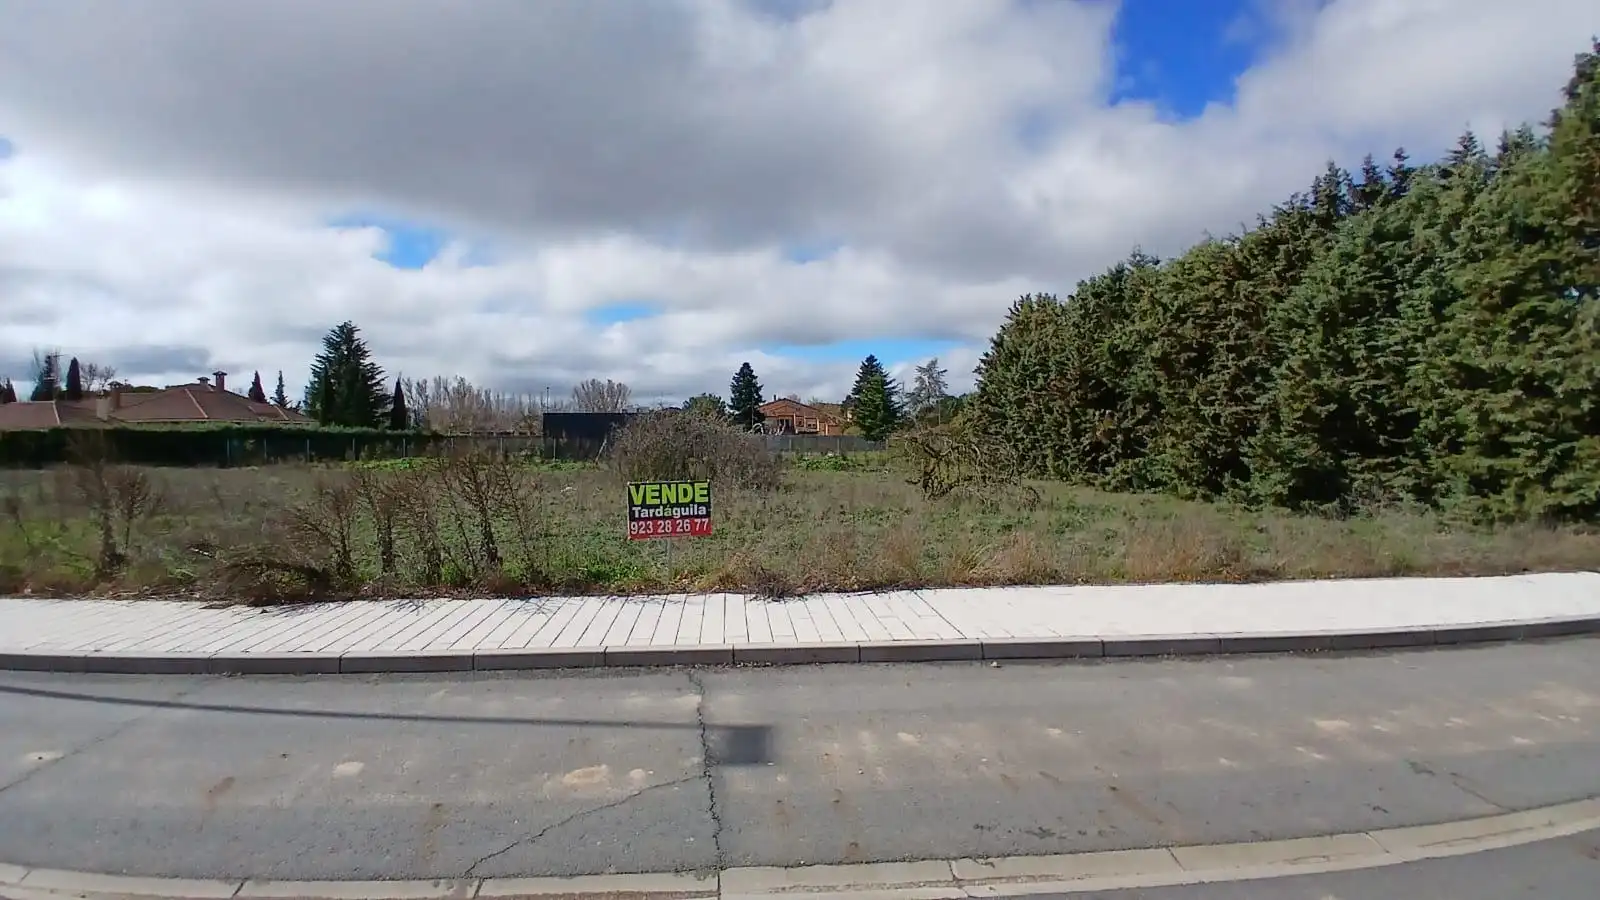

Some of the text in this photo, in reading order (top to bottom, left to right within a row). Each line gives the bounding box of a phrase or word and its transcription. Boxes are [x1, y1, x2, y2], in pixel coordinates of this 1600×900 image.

[629, 482, 709, 505] VENDE
[632, 504, 707, 518] Tardáguila
[630, 518, 709, 535] 923 28 26 77
